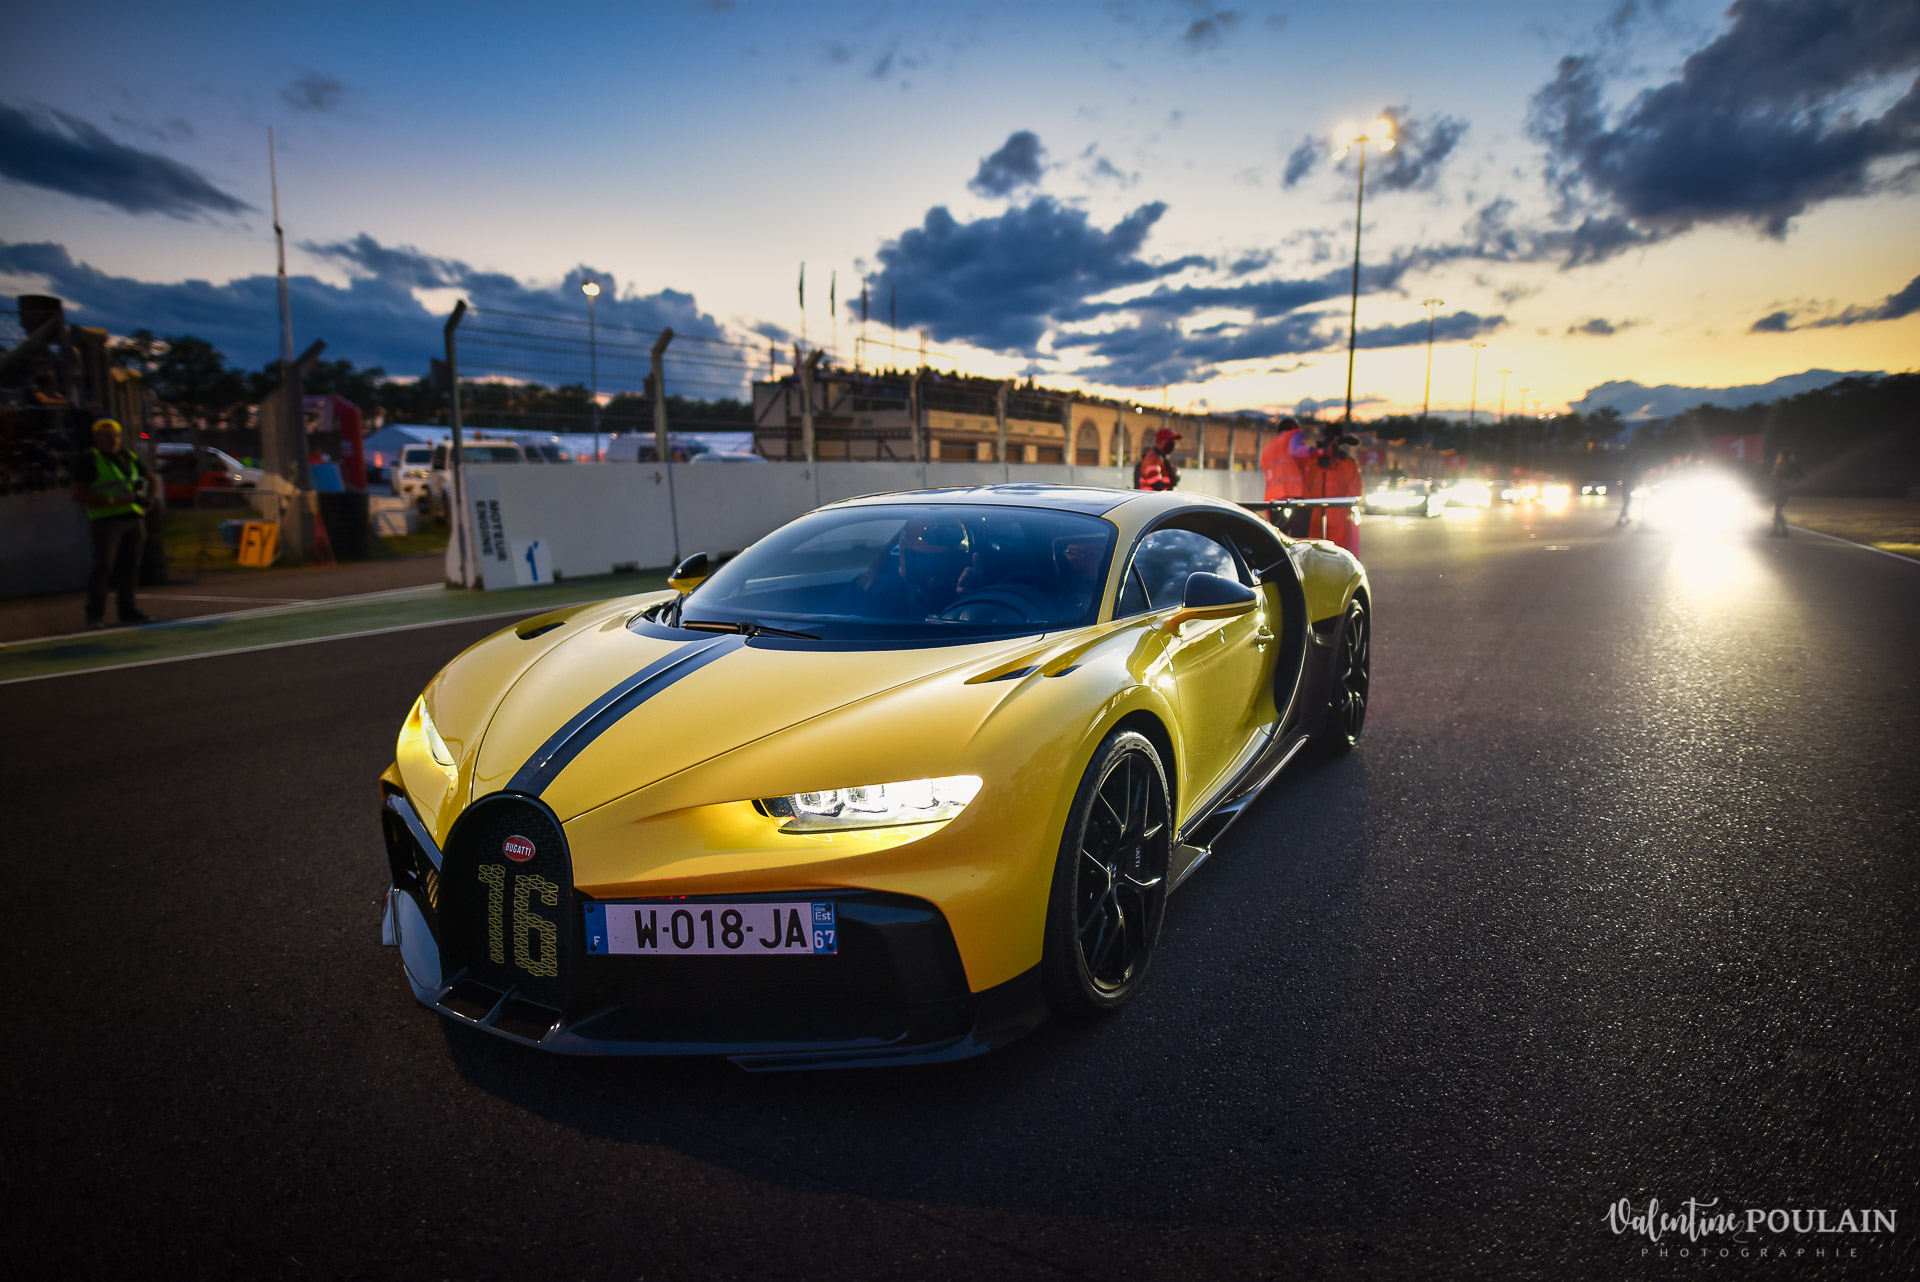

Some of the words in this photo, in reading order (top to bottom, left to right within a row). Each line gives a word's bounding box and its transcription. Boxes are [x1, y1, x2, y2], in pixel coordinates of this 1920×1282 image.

[1730, 439, 1745, 458] 1
[476, 500, 494, 555] ENGINE
[488, 500, 507, 561] MOTEUR
[244, 525, 275, 563] FY
[505, 842, 532, 857] BUGATTI
[478, 864, 559, 977] 16
[815, 911, 832, 920] Est
[593, 936, 601, 946] F
[814, 930, 835, 949] 67
